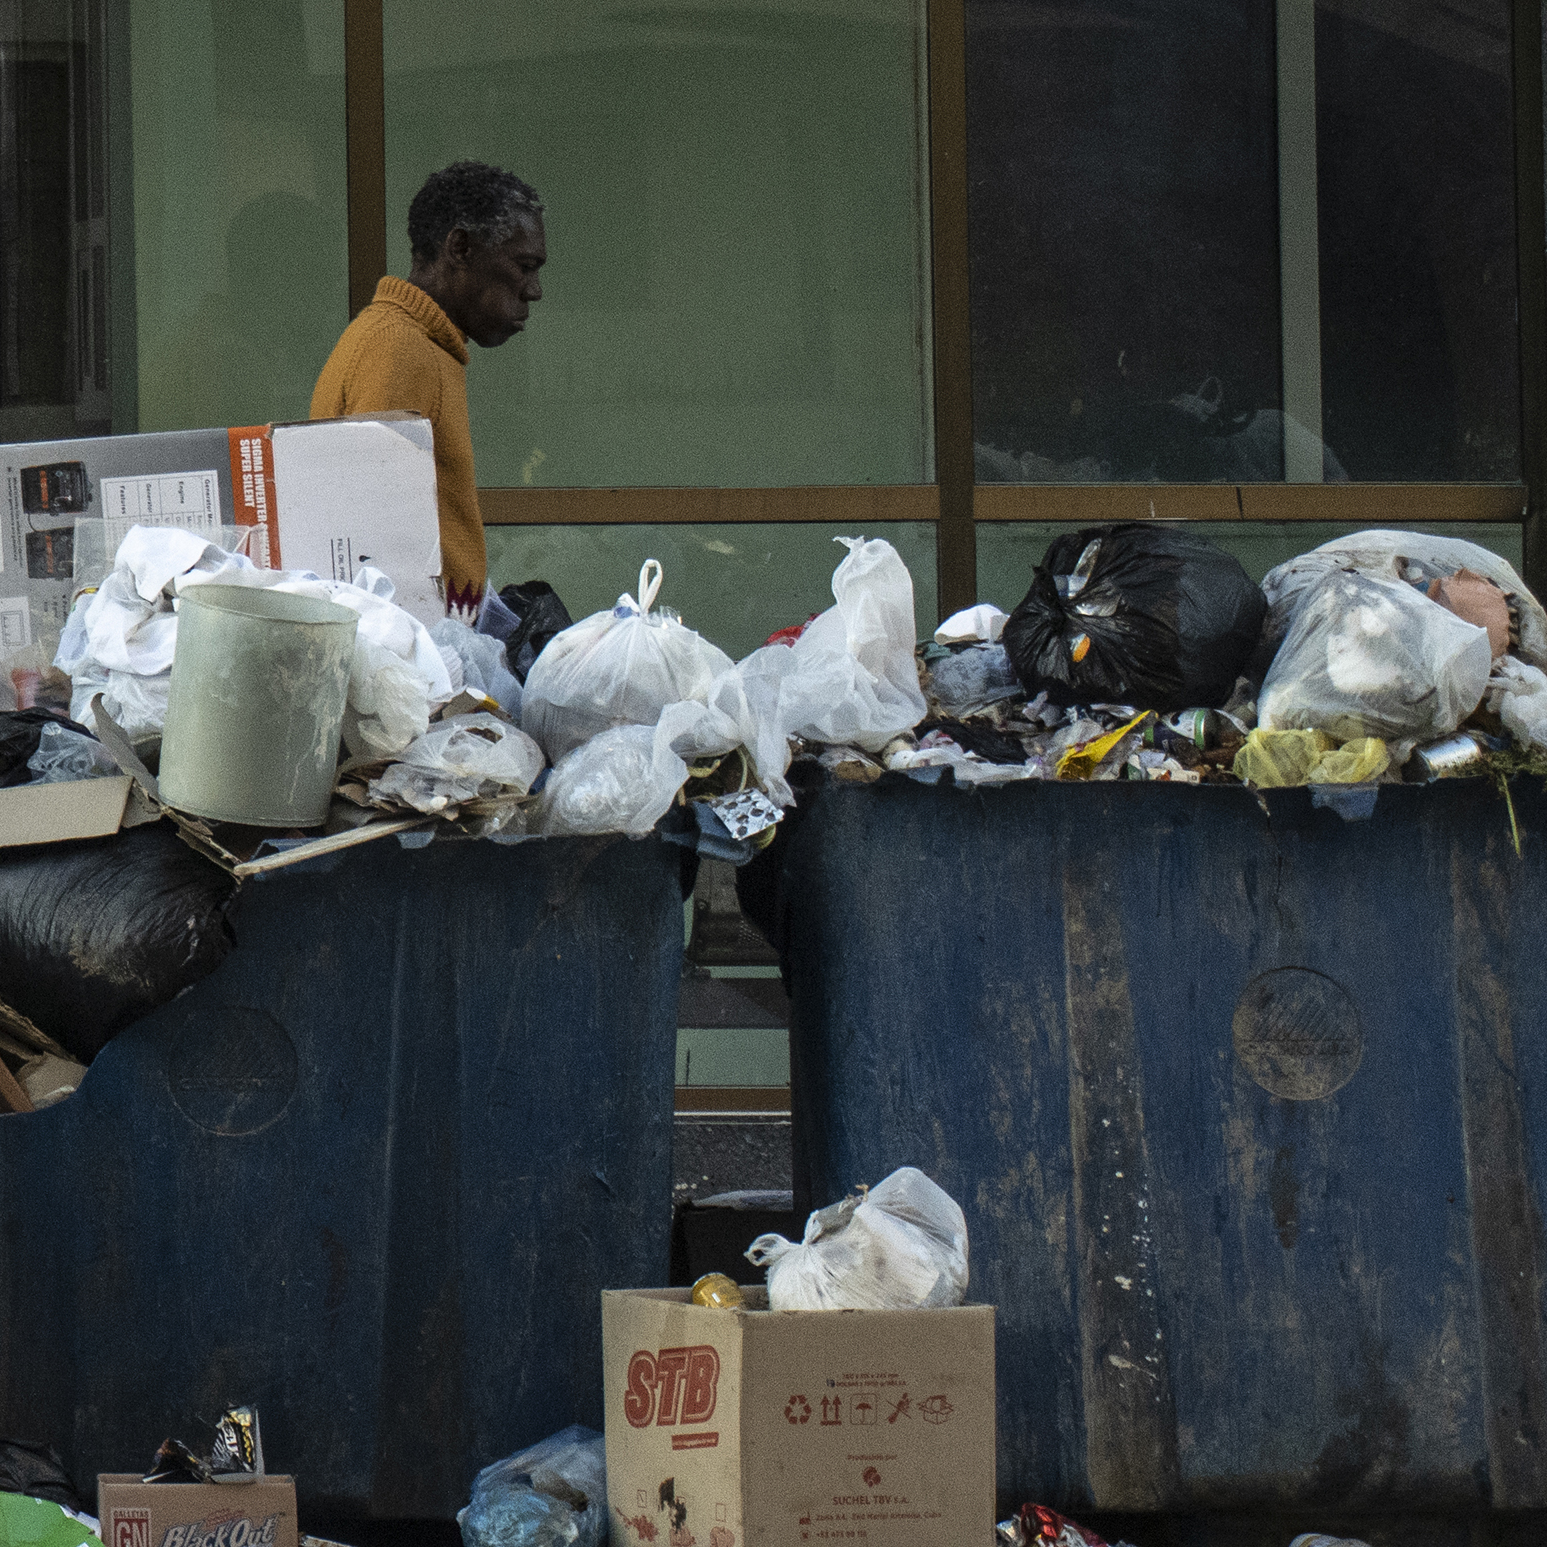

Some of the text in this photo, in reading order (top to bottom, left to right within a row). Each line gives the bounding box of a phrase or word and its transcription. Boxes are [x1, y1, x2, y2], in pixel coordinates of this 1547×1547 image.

[251, 437, 264, 472] SIGMA
[240, 438, 255, 508] SUPER SILENT
[204, 478, 212, 512] Generator
[254, 473, 267, 522] INVERTER
[623, 1344, 721, 1429] STB
[113, 1510, 149, 1518] GALLETAS
[833, 1495, 871, 1506] SUCHEL
